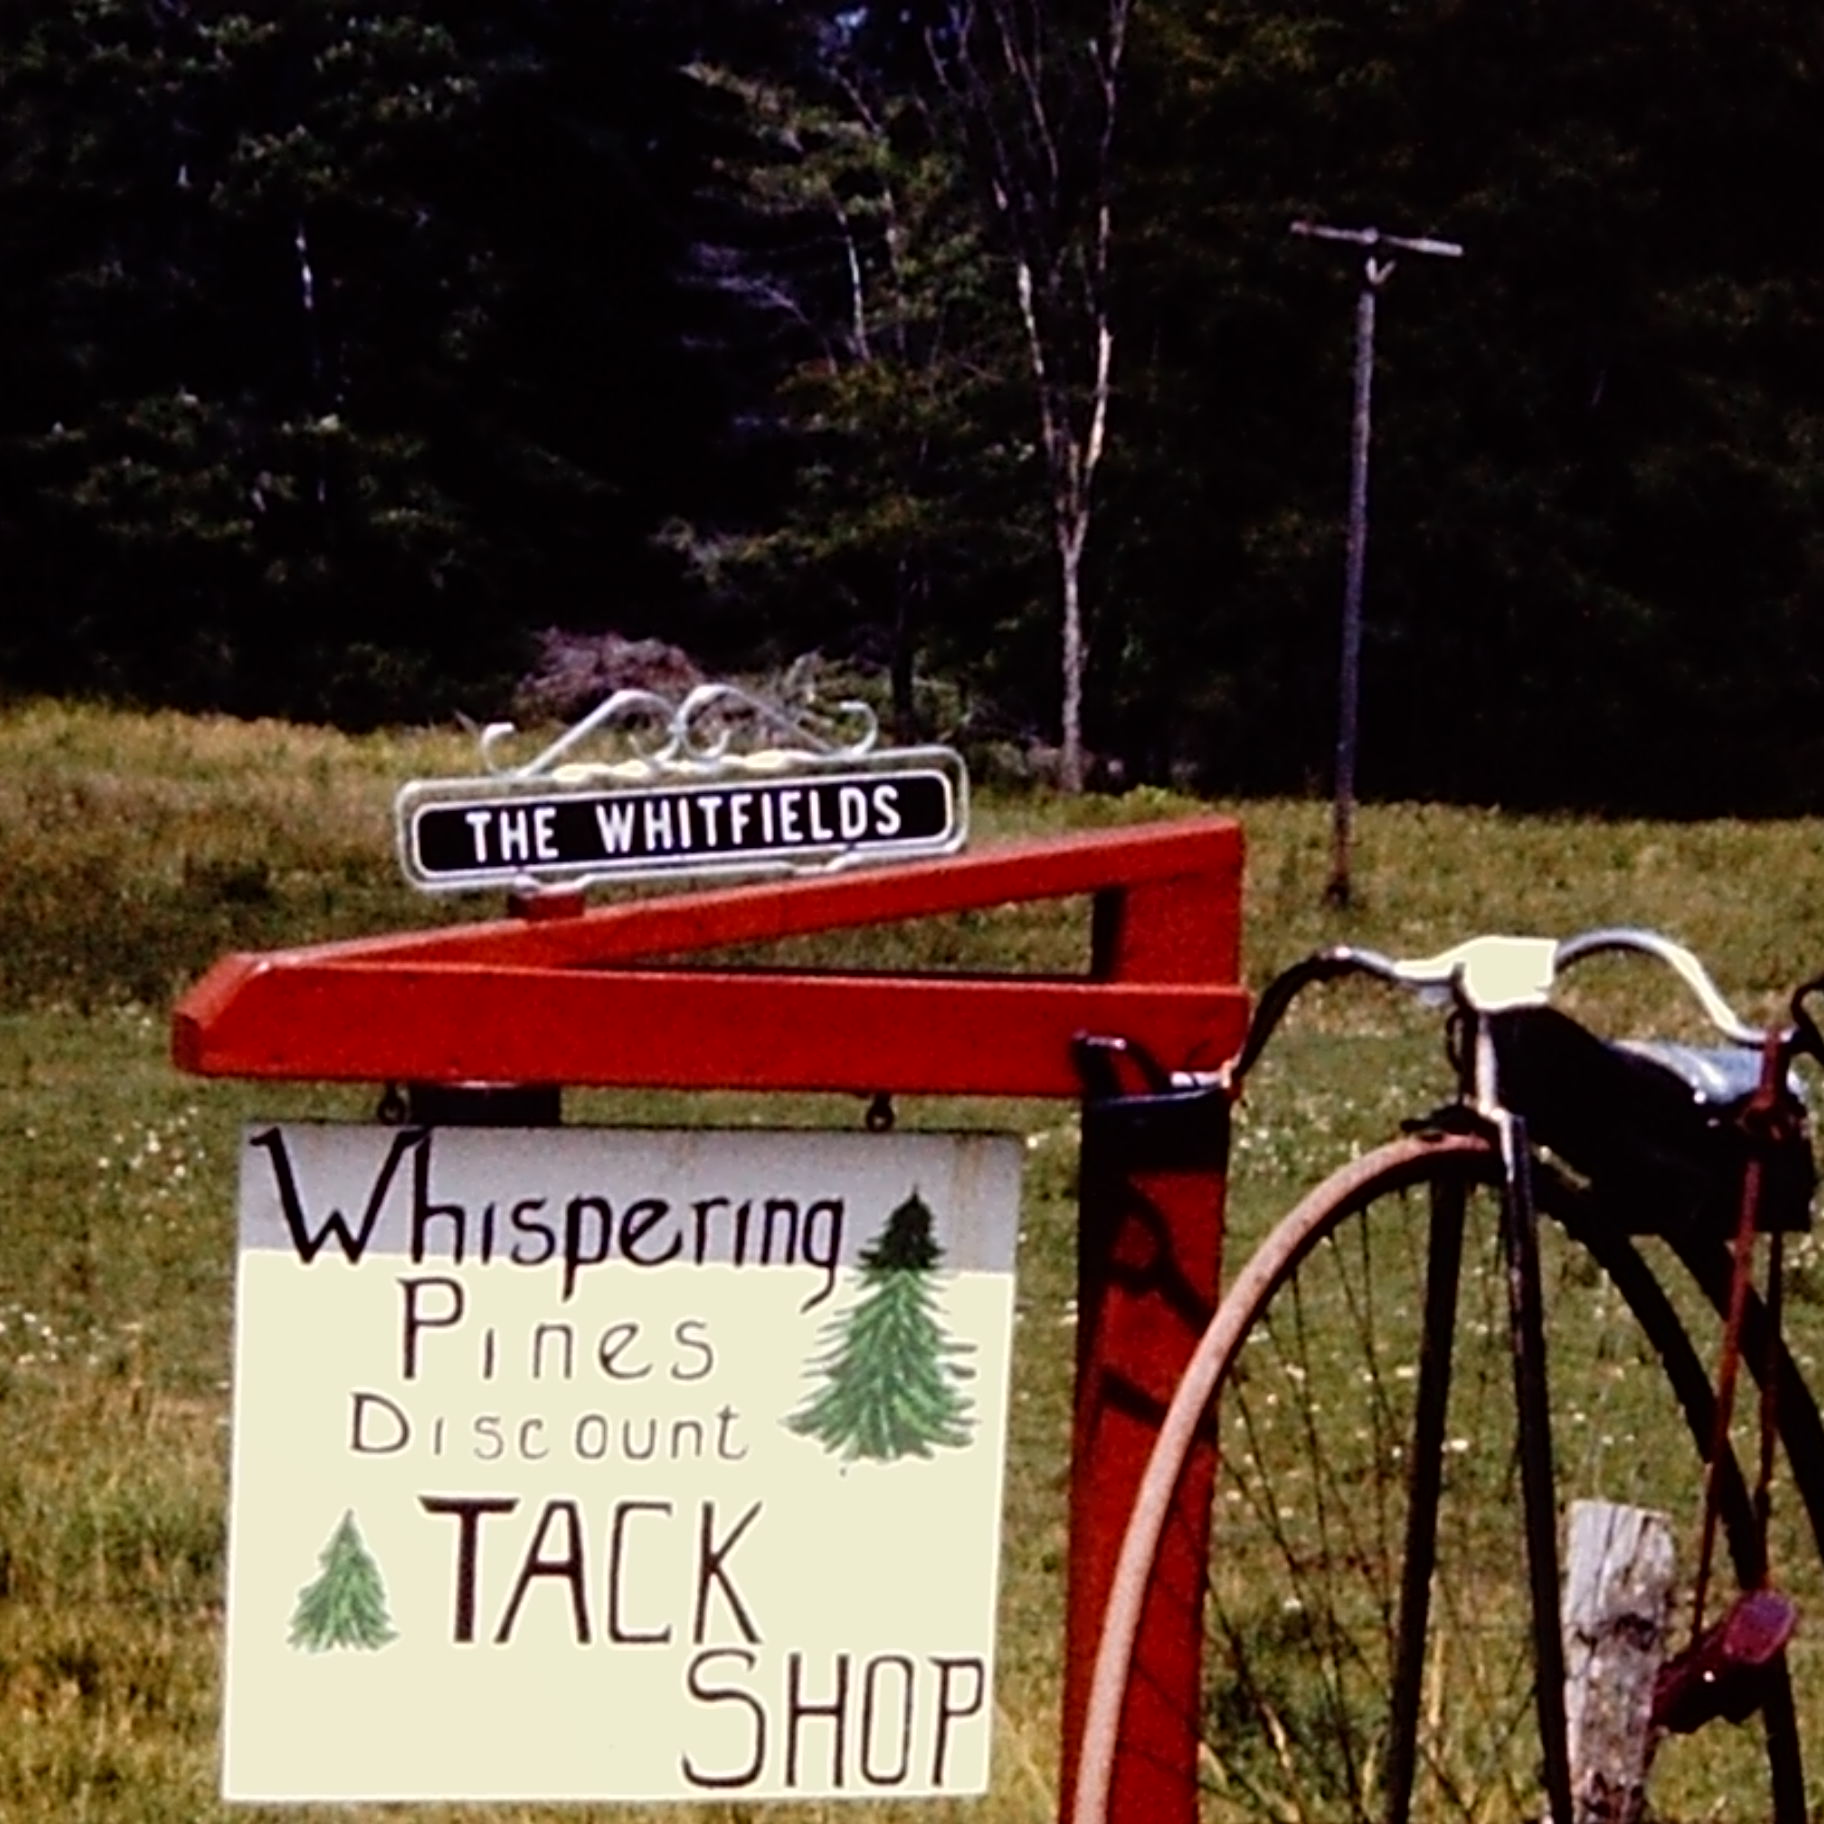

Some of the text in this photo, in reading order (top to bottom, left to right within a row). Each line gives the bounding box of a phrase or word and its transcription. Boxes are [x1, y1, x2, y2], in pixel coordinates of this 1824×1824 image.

[465, 784, 902, 863] THE WHITFIELDS
[250, 1126, 846, 1313] Whispering
[397, 1276, 716, 1381] Pines
[349, 1393, 750, 1461] Discount
[419, 1496, 764, 1645] TACK
[682, 1648, 985, 1789] SHOP
